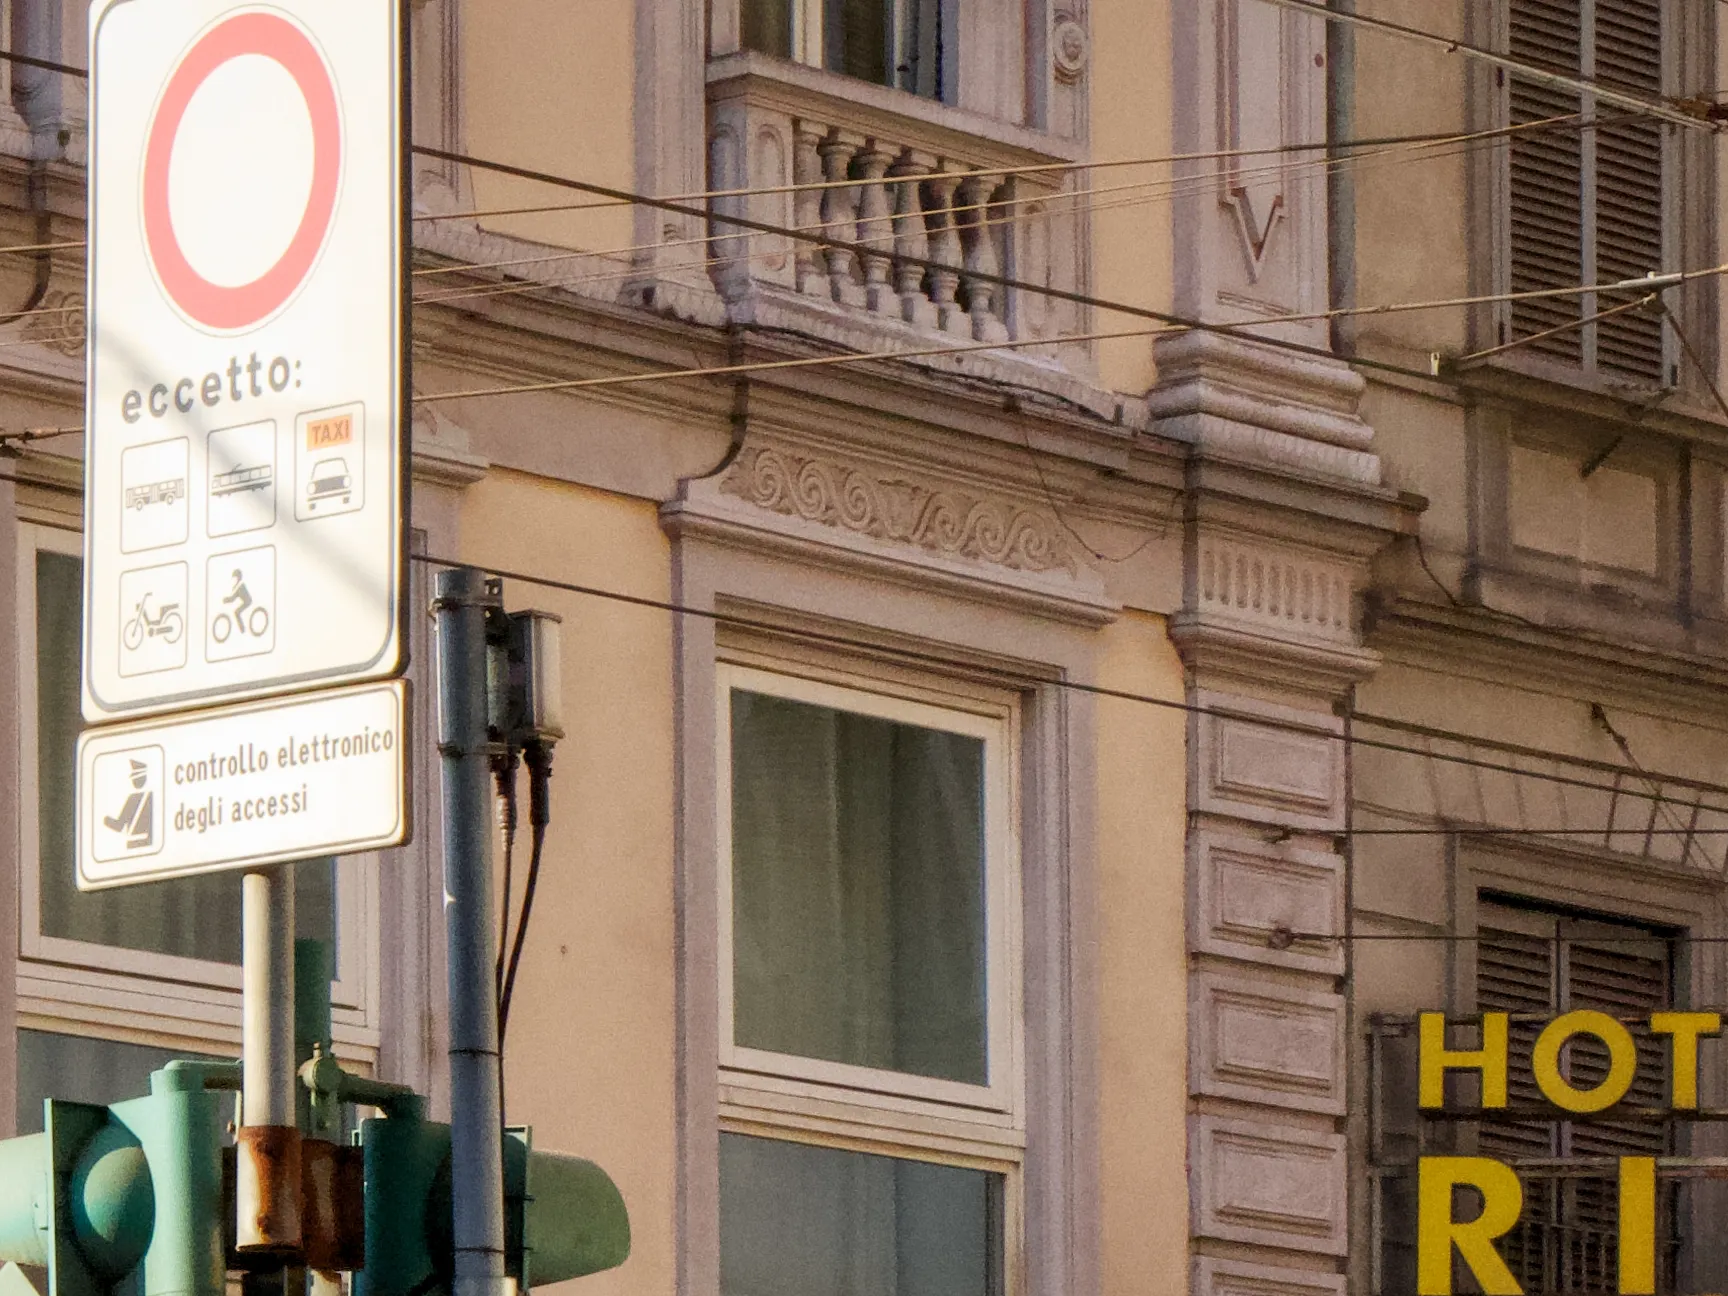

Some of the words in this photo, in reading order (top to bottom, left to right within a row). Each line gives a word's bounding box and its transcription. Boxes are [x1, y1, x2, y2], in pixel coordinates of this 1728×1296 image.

[121, 351, 303, 423] eccetto:
[310, 419, 353, 447] TAXI
[174, 740, 268, 785] controllo
[276, 727, 394, 768] elettronico
[174, 797, 223, 834] degli
[230, 785, 308, 822] accessi
